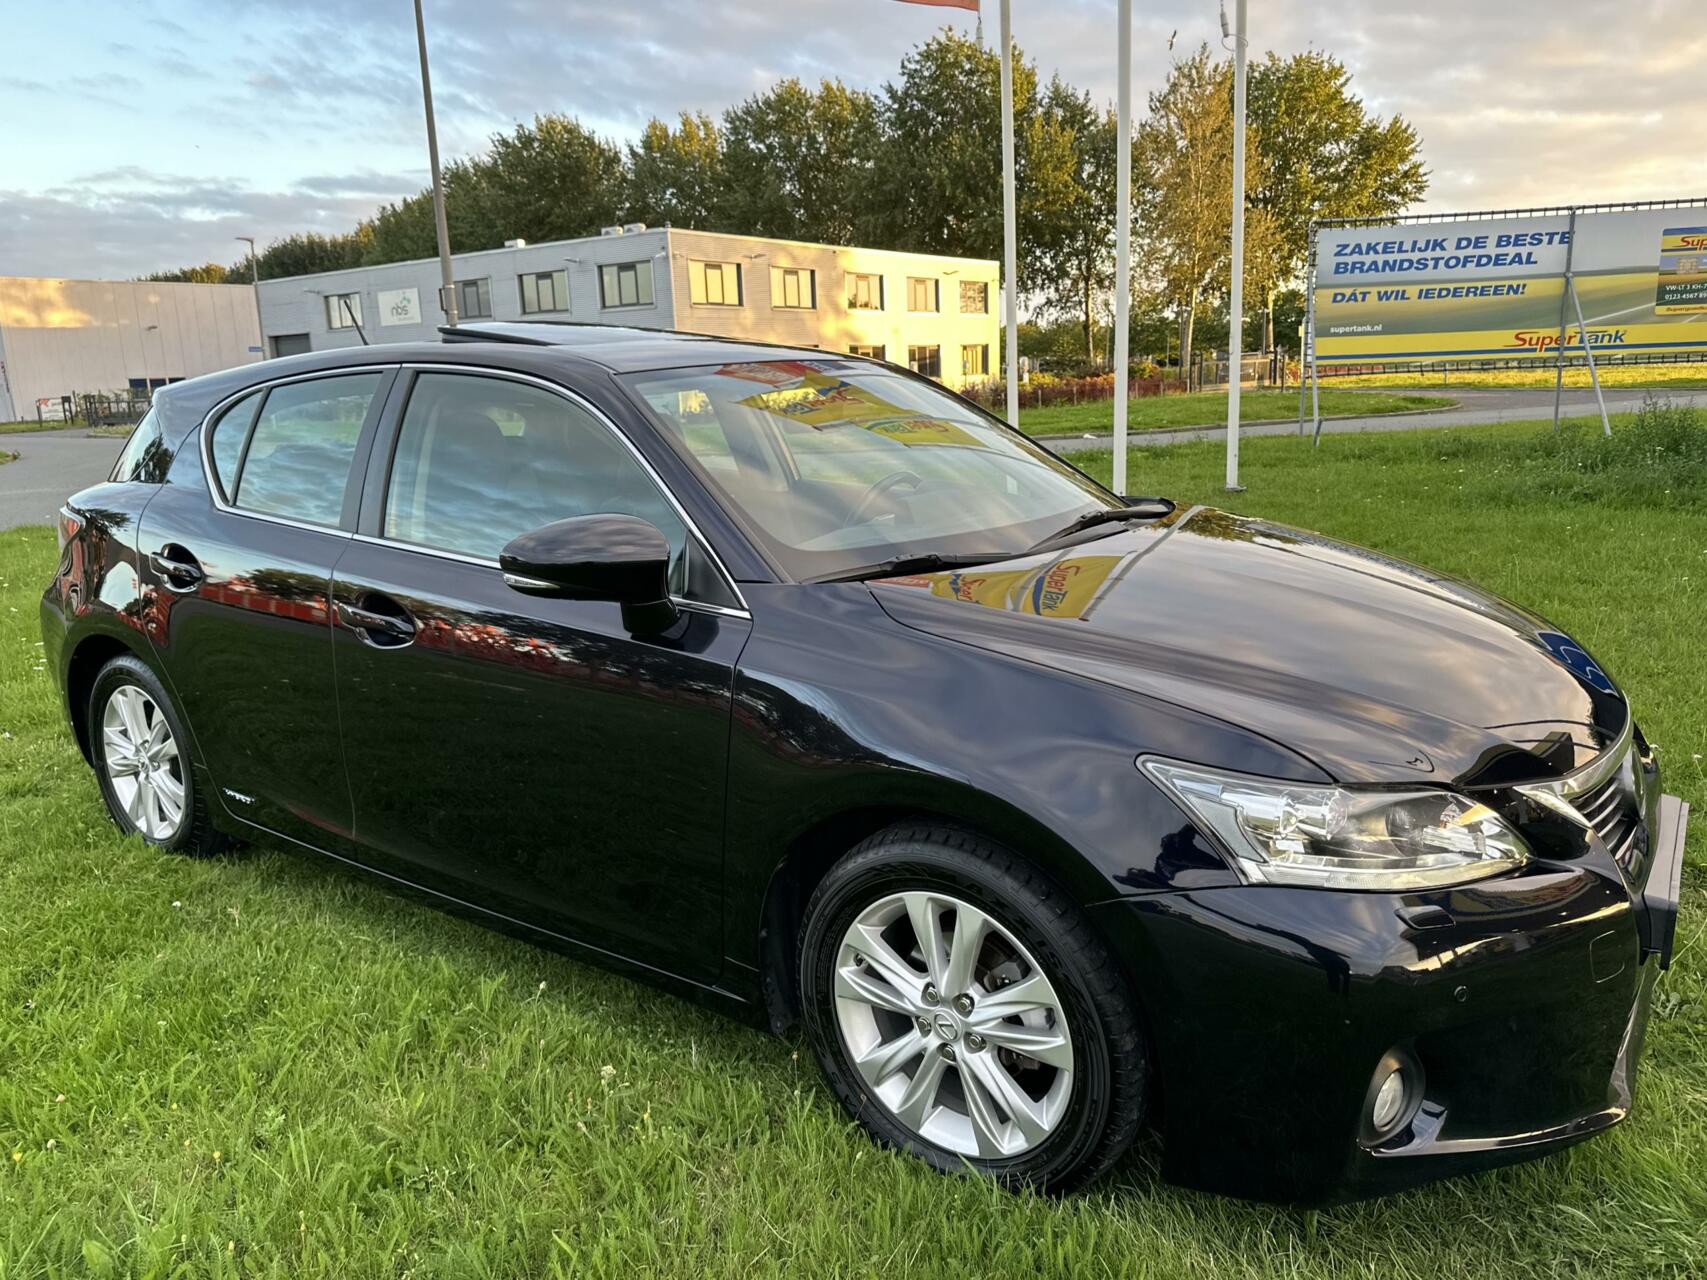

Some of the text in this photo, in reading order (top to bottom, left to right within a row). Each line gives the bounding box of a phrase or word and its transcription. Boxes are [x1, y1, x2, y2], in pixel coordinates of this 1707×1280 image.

[1333, 230, 1575, 257] ZAKELIJK DE BESTE
[1333, 251, 1538, 275] BRANDSTOFDEAL
[1331, 283, 1527, 304] DÁT WIL IEDEREEN!
[1330, 324, 1382, 334] supertank.nl
[1504, 330, 1626, 352] SuperTank
